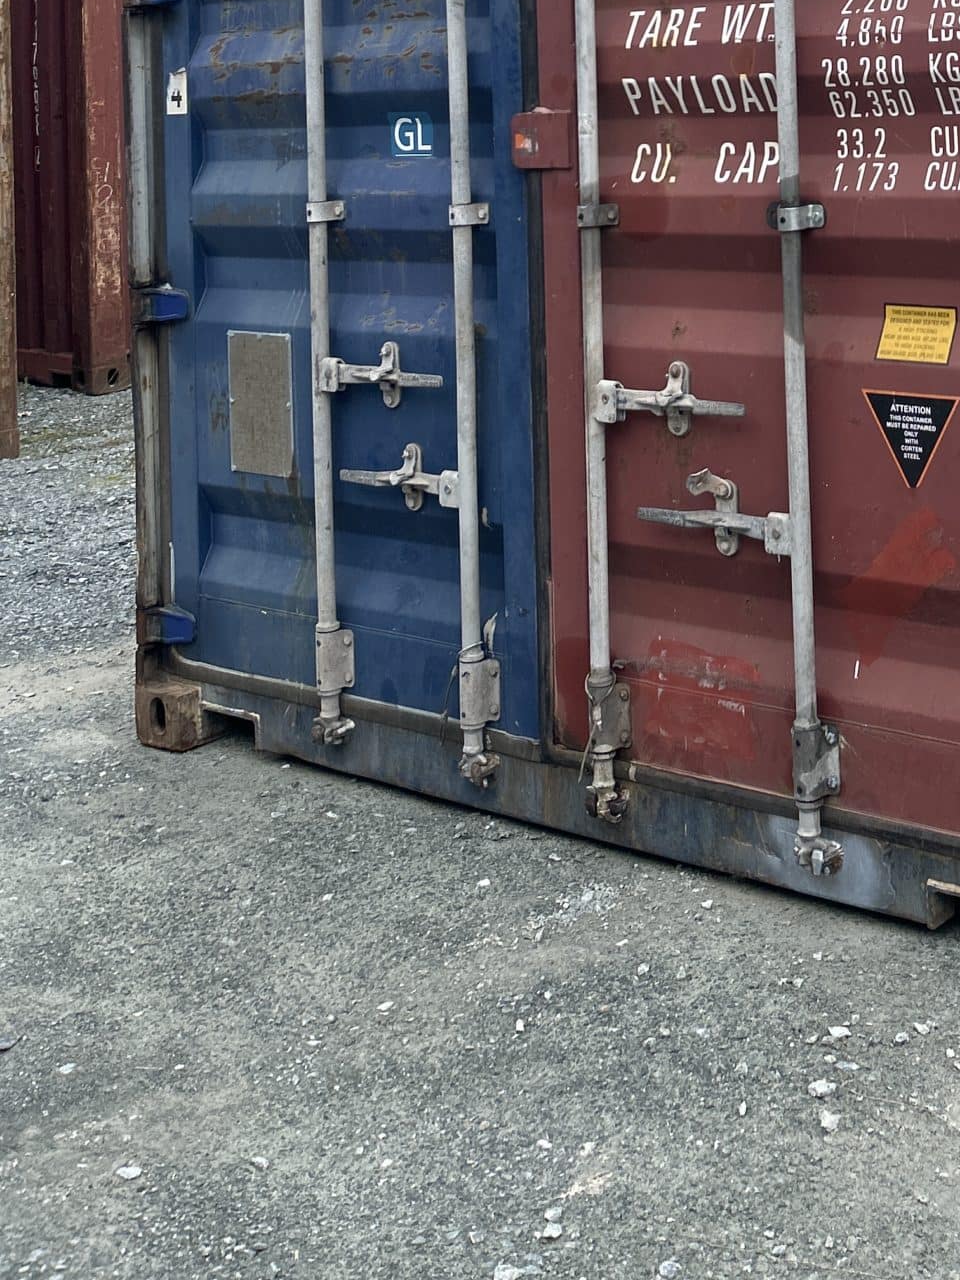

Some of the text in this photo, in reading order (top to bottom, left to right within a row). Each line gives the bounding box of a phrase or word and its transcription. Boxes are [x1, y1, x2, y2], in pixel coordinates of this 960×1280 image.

[625, 7, 706, 49] TARE
[171, 89, 182, 108] 4
[622, 73, 778, 115] PAYLOAD
[394, 118, 432, 152] GL
[837, 128, 886, 158] 33.2
[631, 143, 676, 183] CU.
[890, 403, 931, 415] ATTENTION
[886, 421, 936, 432] MUST BE REPAIRED
[889, 414, 932, 424] THIS CONTAINER
[904, 430, 918, 438] ONLY
[901, 445, 923, 453] CORTEN
